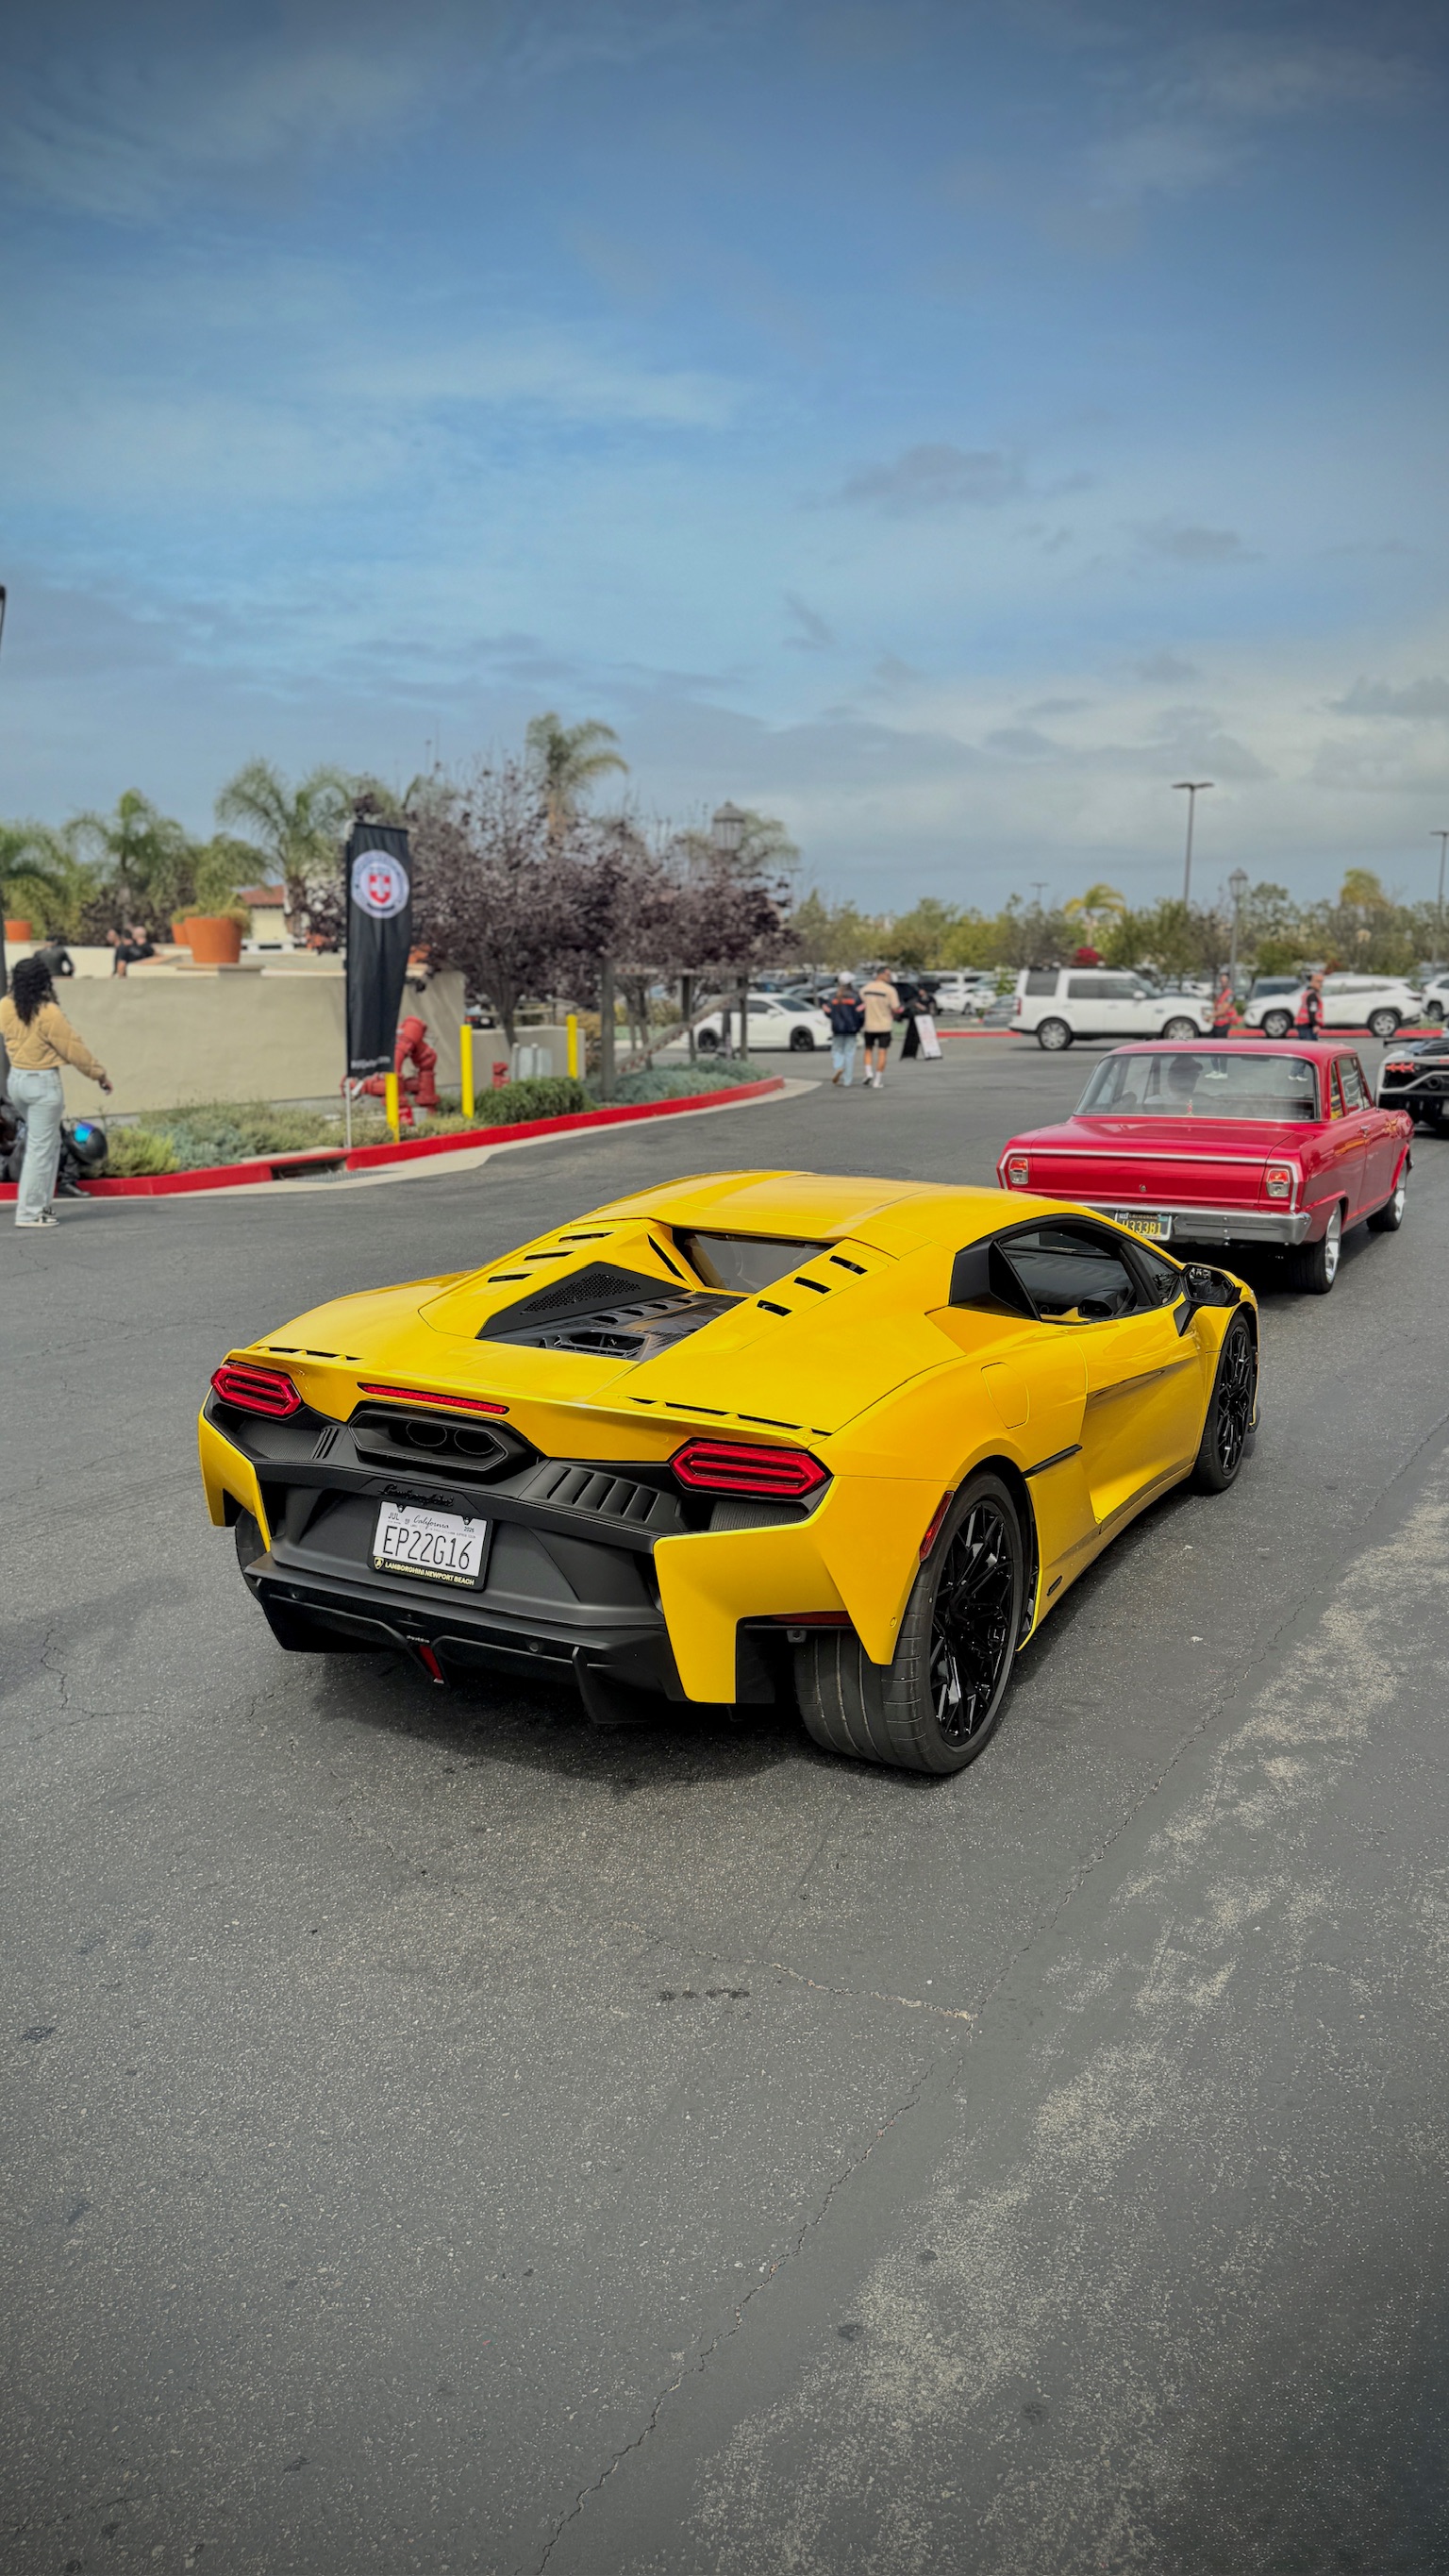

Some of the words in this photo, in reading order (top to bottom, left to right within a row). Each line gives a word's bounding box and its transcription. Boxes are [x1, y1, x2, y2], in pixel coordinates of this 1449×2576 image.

[388, 1512, 400, 1521] JUL
[413, 1514, 449, 1530] California
[382, 1525, 473, 1570] EP22G16
[385, 1562, 425, 1576] LAMBORGHINI
[425, 1569, 454, 1581] NEWPORT
[454, 1576, 475, 1586] BEACH
